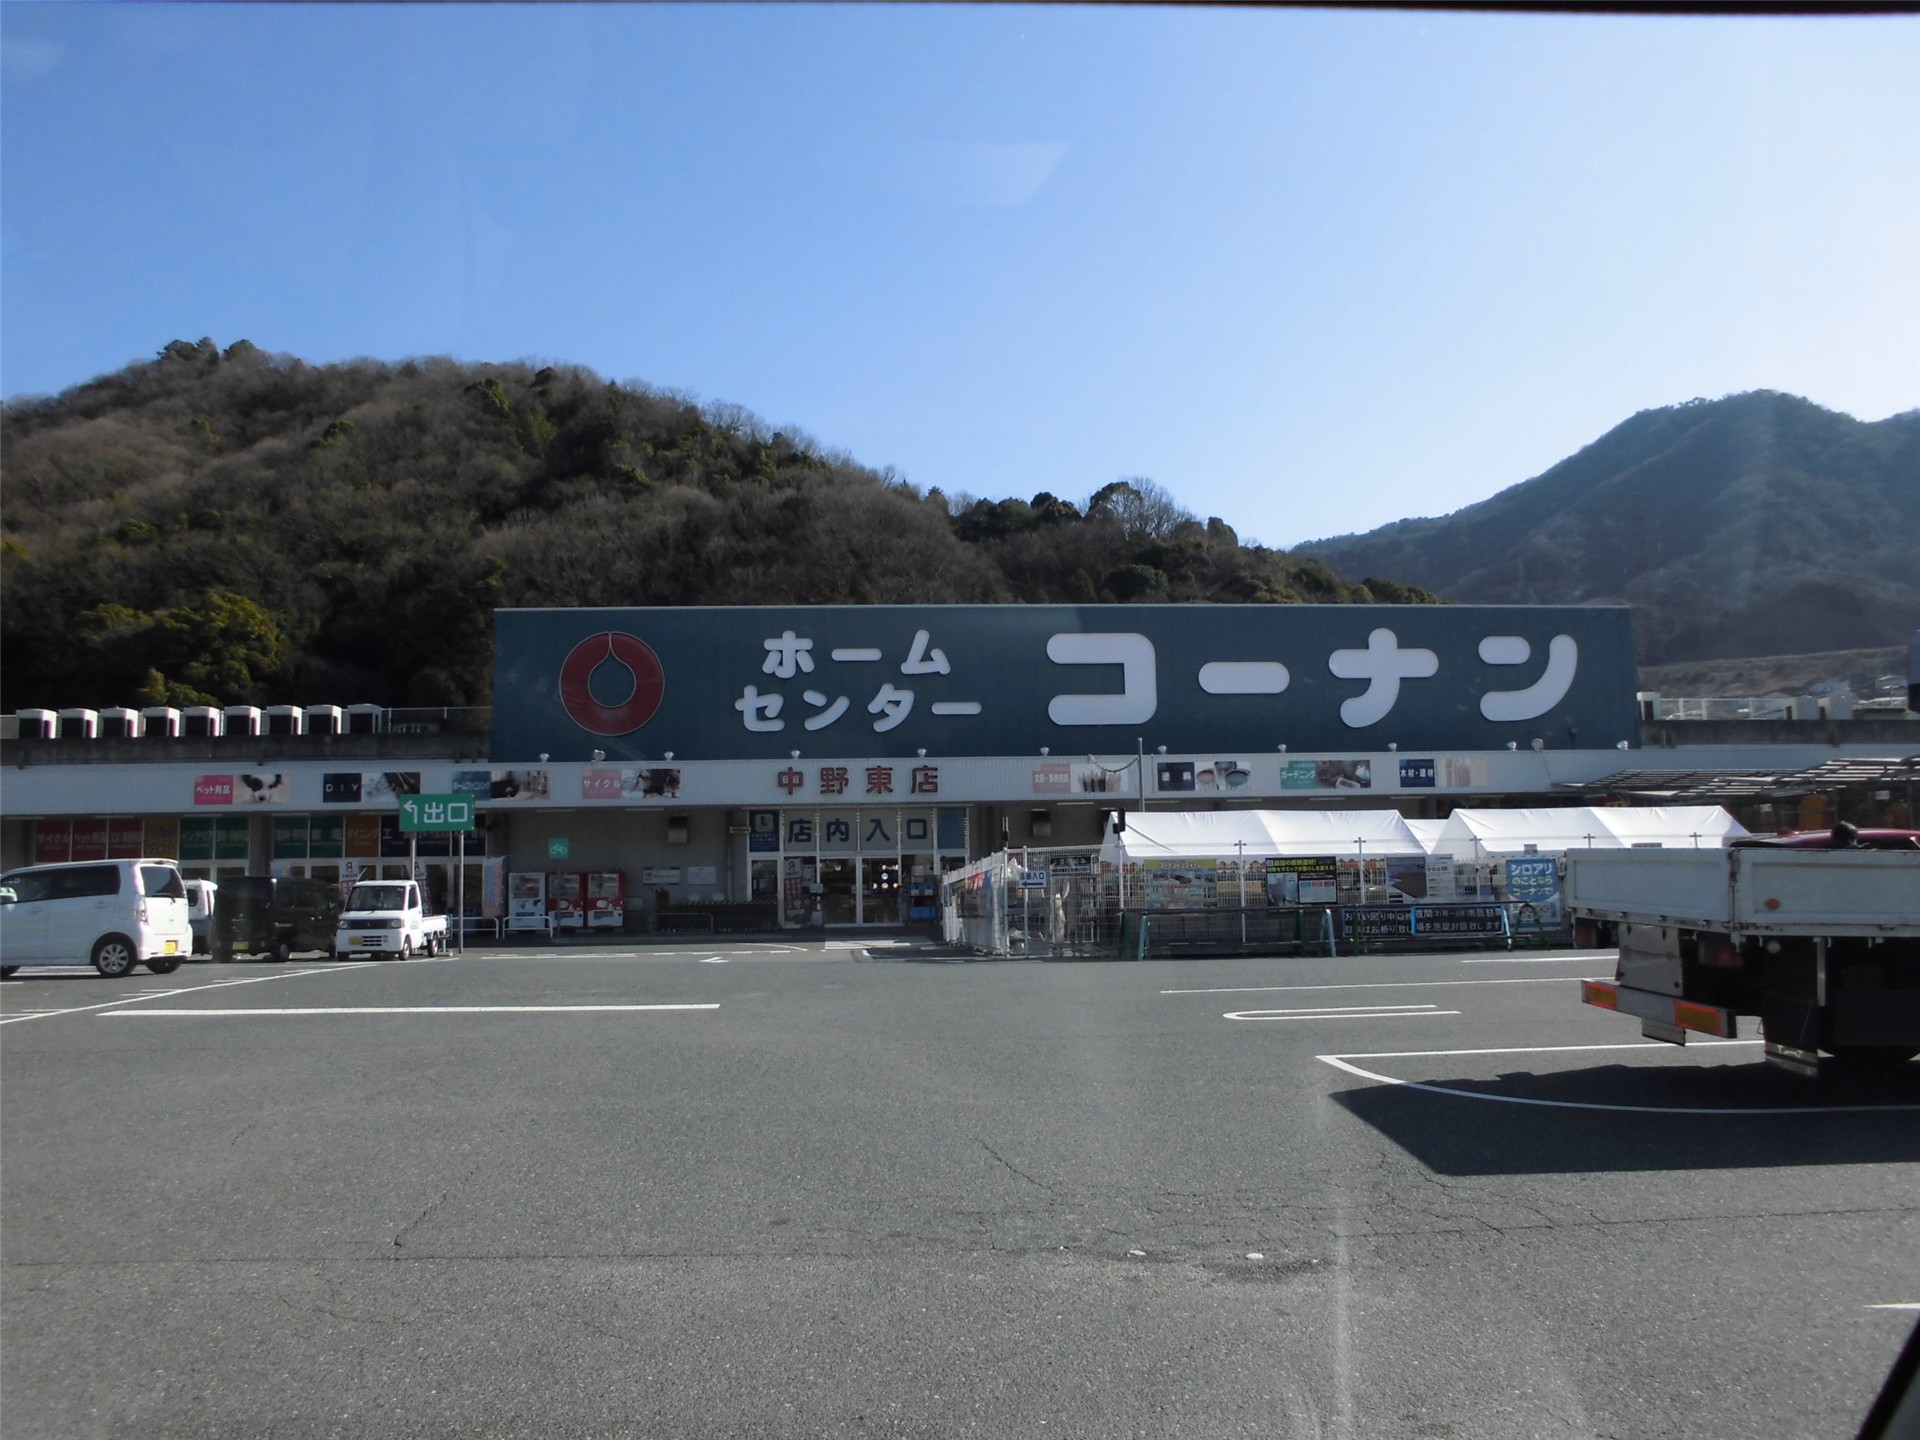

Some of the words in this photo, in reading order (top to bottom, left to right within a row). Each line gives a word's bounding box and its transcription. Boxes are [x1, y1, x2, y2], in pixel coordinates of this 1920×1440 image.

[763, 630, 950, 678] ホーム
[1046, 628, 1577, 728] コーナン
[735, 685, 980, 732] センター
[583, 779, 620, 789] サイクル
[778, 765, 939, 796] 中野東店
[1281, 769, 1316, 779] ガーデニング
[196, 785, 231, 794] ペット用品
[424, 801, 469, 823] 出口
[788, 818, 928, 843] 店内入口
[1511, 863, 1553, 875] シロアリ
[1511, 876, 1553, 885] のことなら
